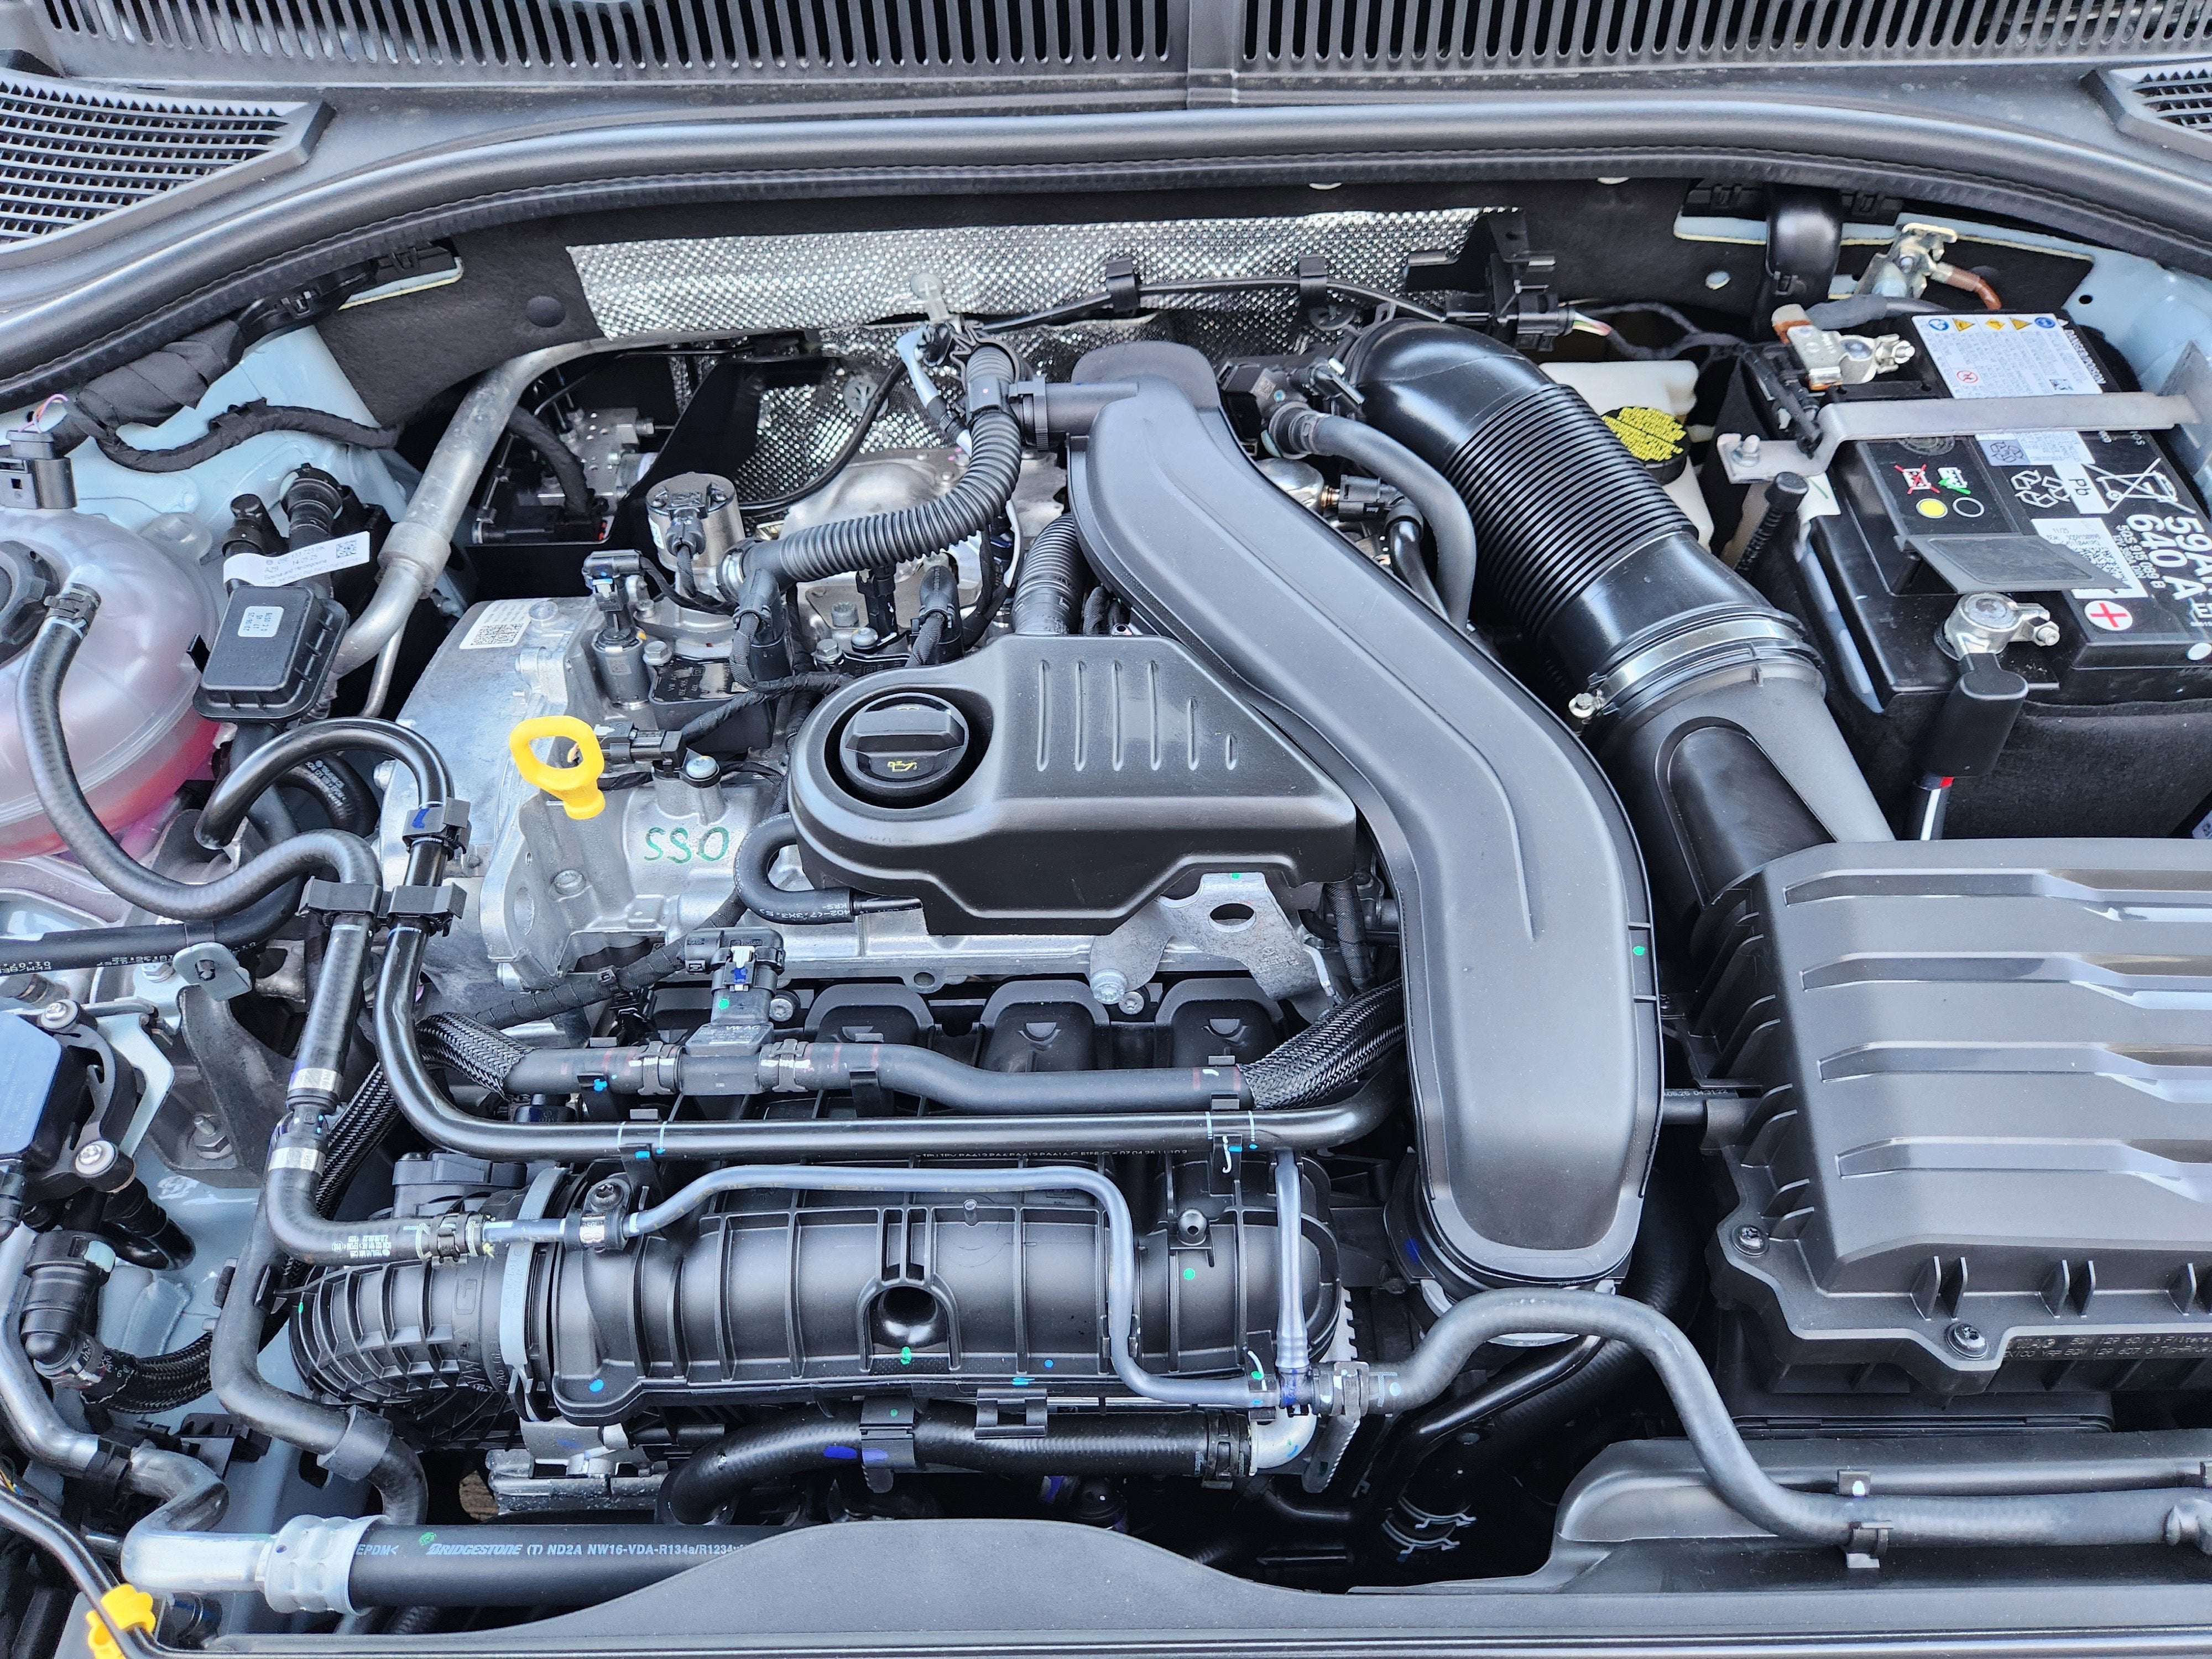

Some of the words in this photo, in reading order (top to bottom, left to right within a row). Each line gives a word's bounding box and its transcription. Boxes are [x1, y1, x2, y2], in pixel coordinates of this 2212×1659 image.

[2069, 478, 2091, 496] Pb
[2126, 514, 2188, 567] 640
[2162, 576, 2207, 600] A
[2164, 516, 2212, 594] 59A
[357, 1544, 399, 1556] EPDM<
[426, 1543, 523, 1556] BRIDGESTONE
[526, 1543, 543, 1556] (T)
[546, 1544, 582, 1556] ND2A
